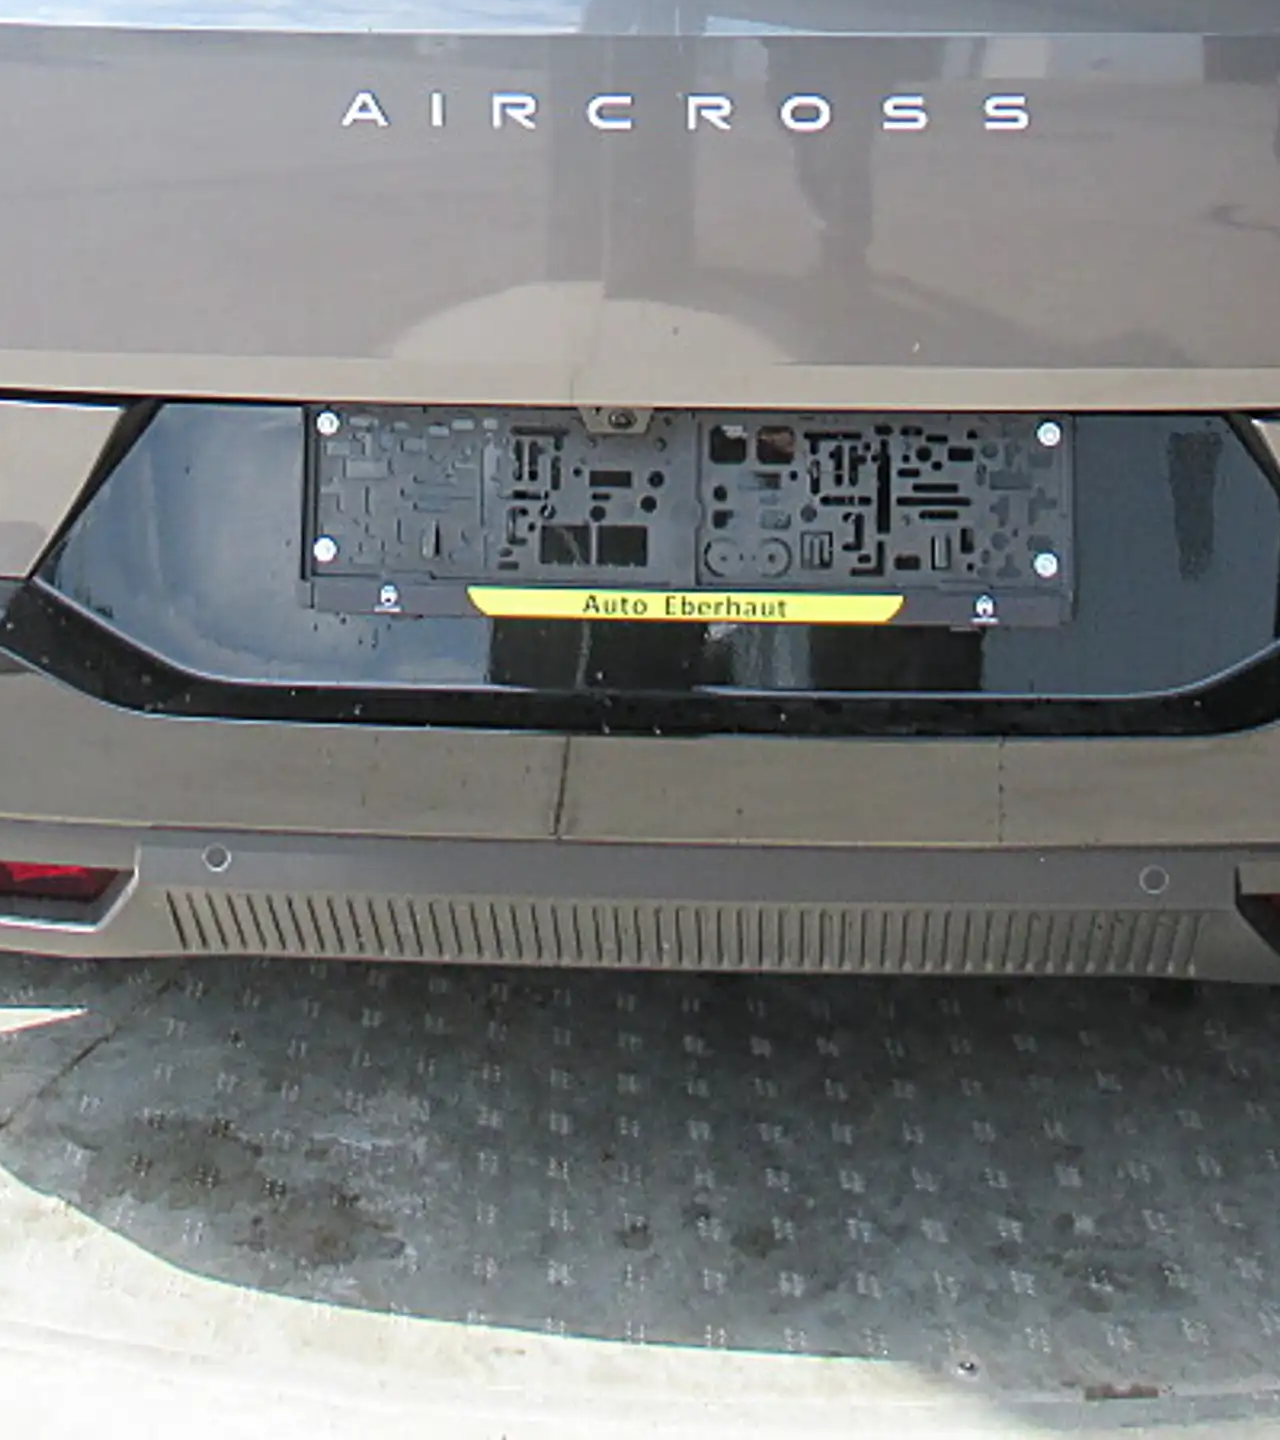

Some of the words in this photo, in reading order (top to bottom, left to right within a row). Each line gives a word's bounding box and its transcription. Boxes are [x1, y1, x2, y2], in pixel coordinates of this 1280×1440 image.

[341, 91, 1030, 131] AIRCROSS
[582, 594, 648, 616] Auto
[665, 595, 787, 618] Eberhaut
